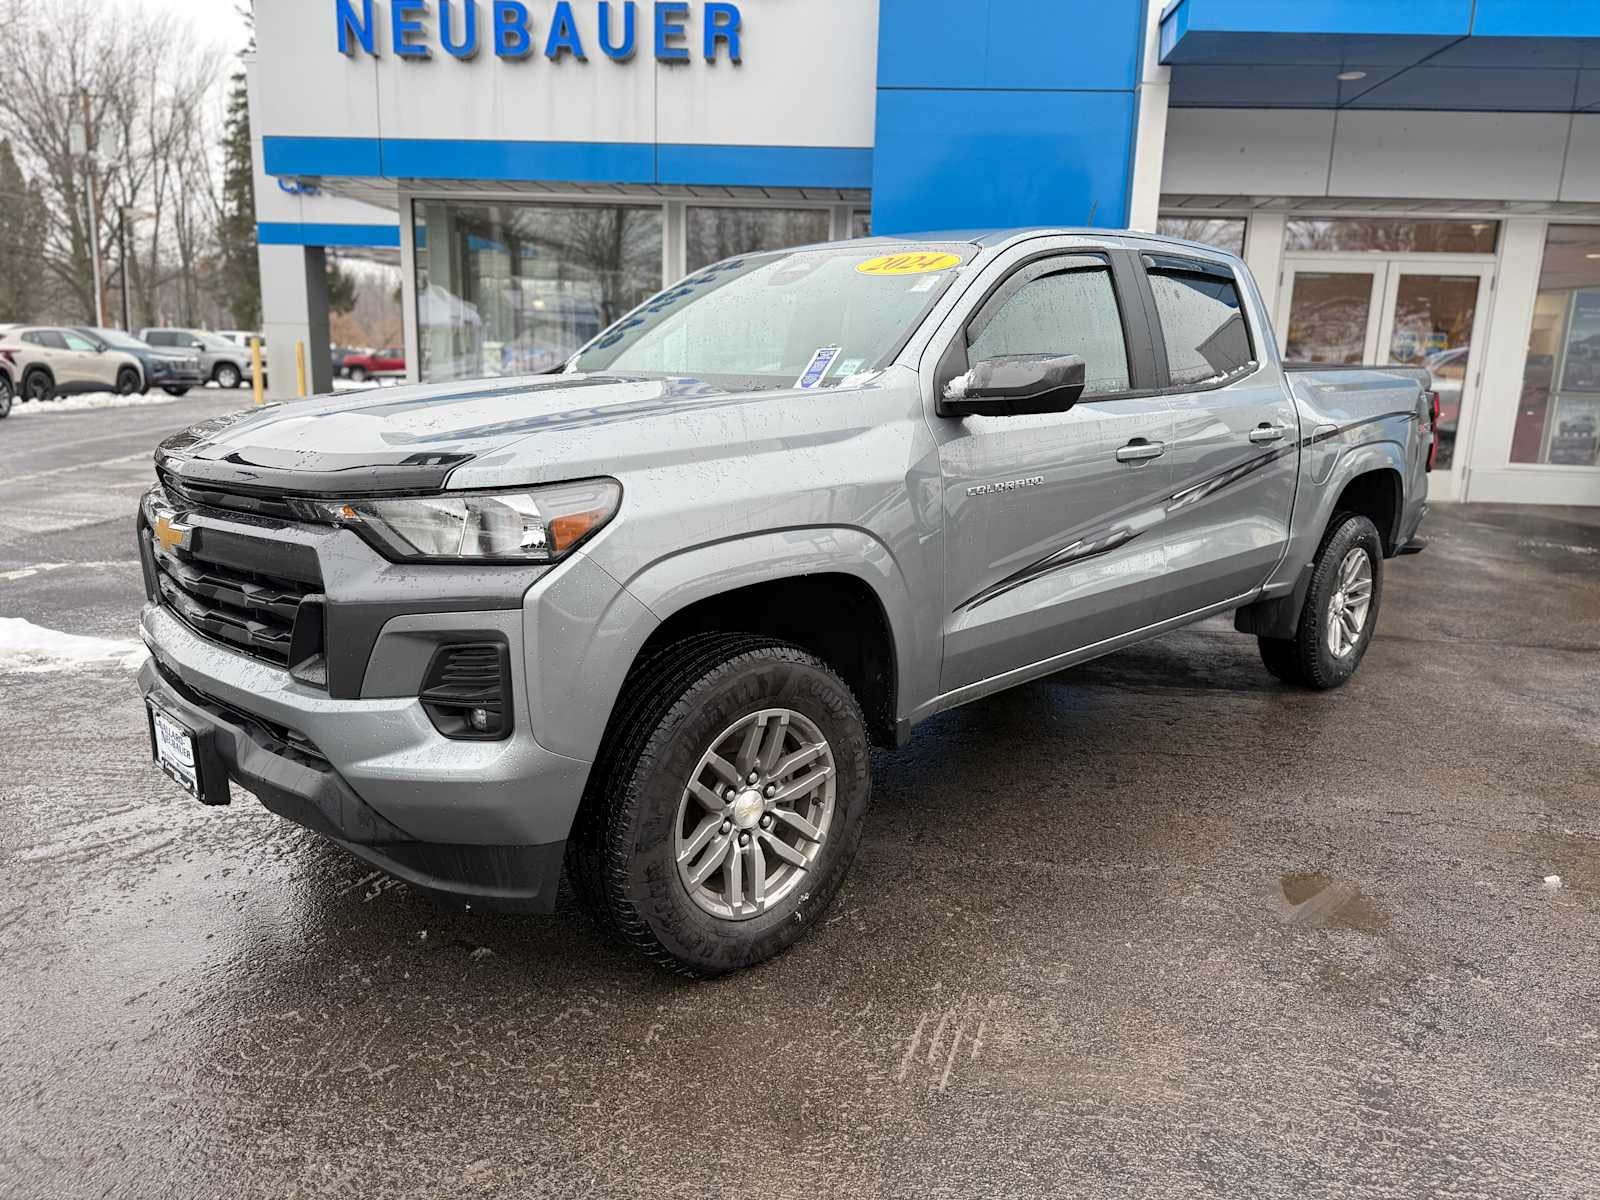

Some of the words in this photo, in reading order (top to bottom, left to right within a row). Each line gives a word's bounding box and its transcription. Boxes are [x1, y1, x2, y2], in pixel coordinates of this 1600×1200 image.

[336, 0, 742, 63] NEUBAUER
[866, 255, 947, 271] 2024
[967, 475, 1044, 497] COLORADO
